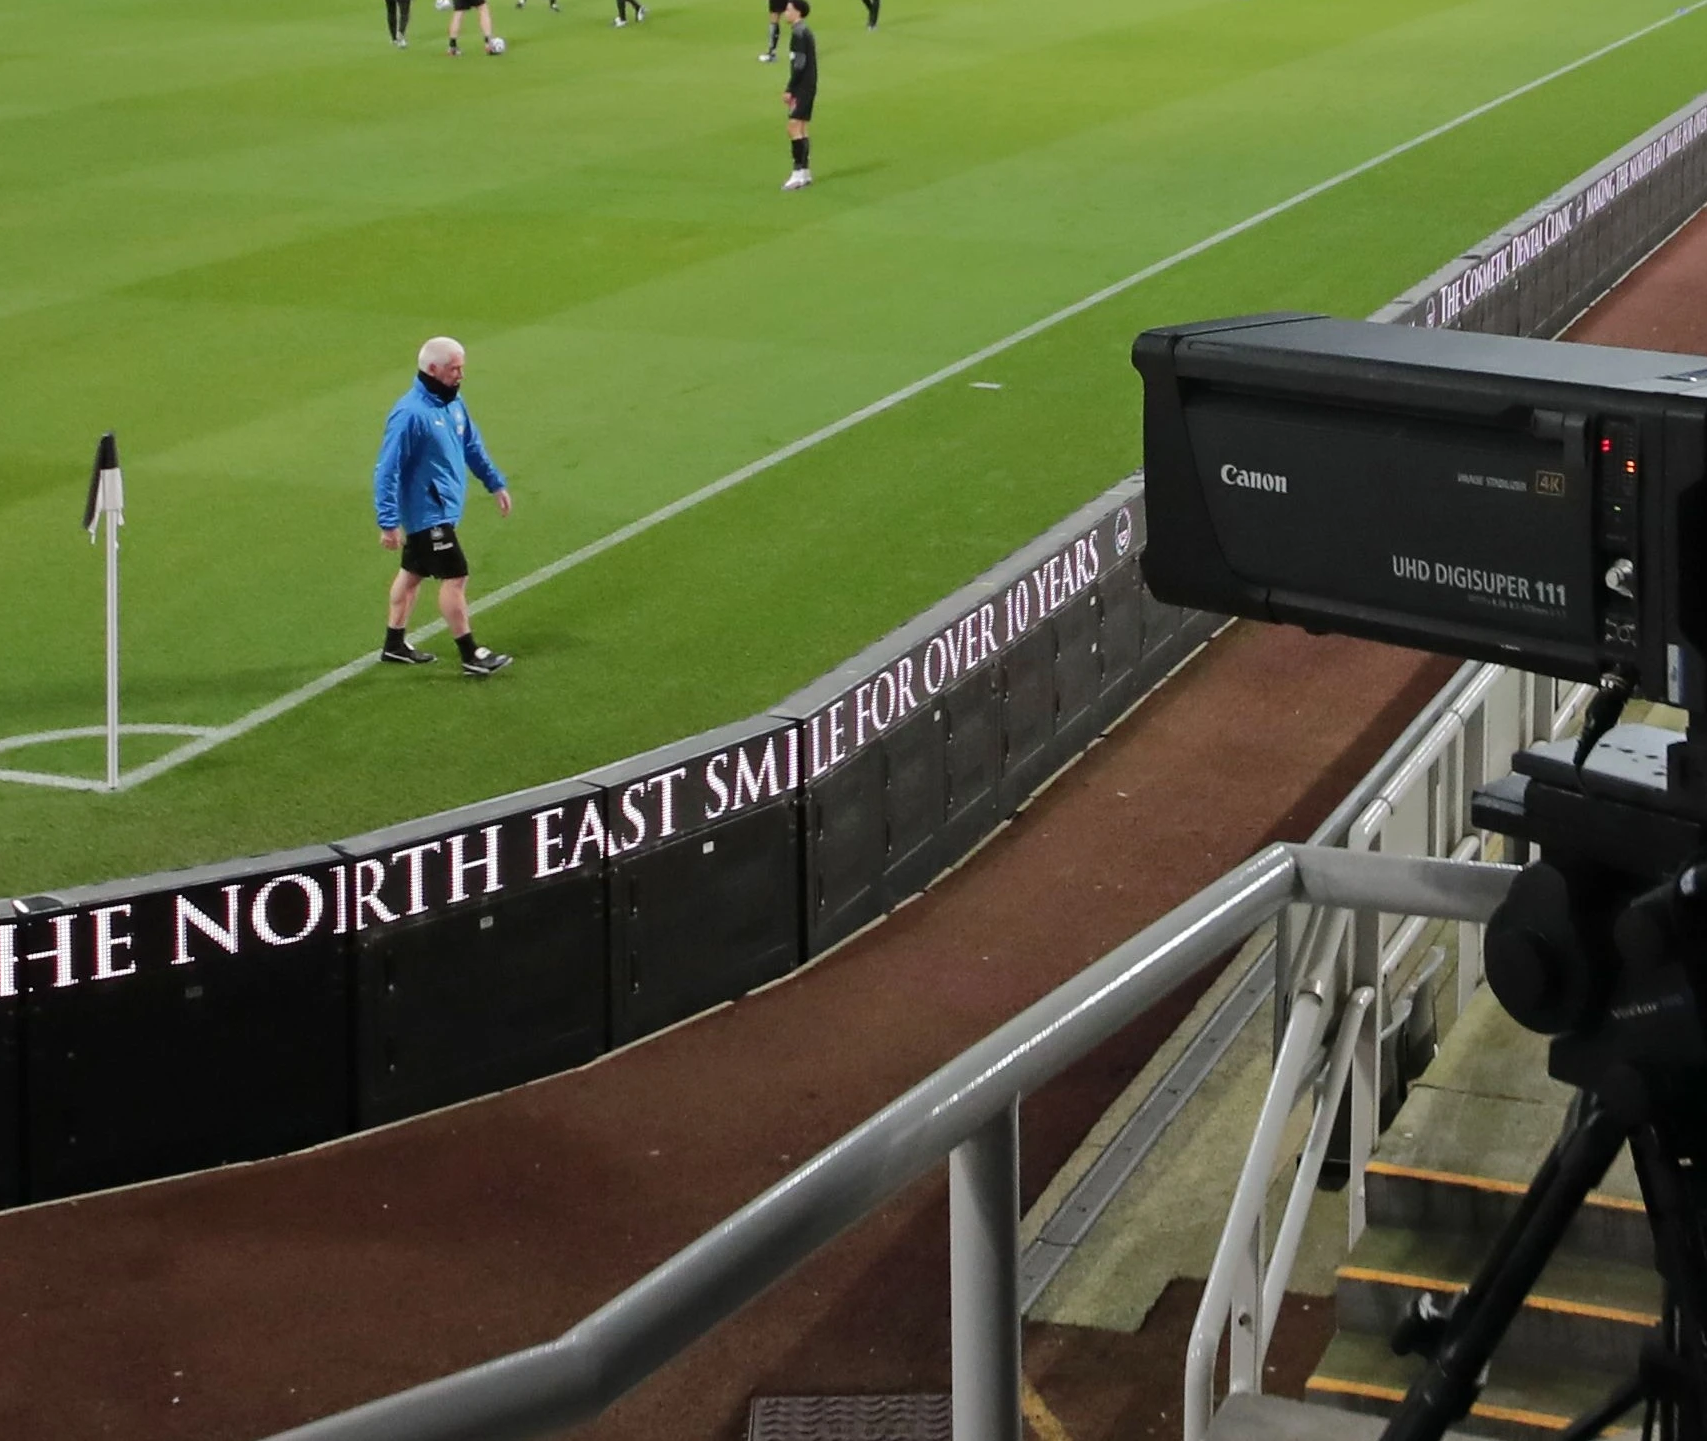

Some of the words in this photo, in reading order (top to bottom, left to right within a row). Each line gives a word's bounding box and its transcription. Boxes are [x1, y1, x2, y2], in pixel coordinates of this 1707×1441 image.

[1440, 280, 1462, 324] THE
[1462, 246, 1511, 306] COSMETIC
[1512, 223, 1544, 271] DENTAL
[1545, 202, 1573, 244] CLINIC
[1220, 464, 1288, 494] Canon
[1539, 475, 1560, 492] 4K
[1392, 554, 1431, 582] UHD
[1435, 562, 1531, 600] DIGISUPER
[1534, 580, 1566, 606] 111
[171, 824, 504, 966] NORTH
[532, 766, 687, 880] EAST
[704, 700, 847, 821] SMILE
[854, 656, 919, 748] FOR
[923, 602, 999, 695] OVER
[1003, 579, 1031, 642] 10
[1031, 529, 1100, 618] YEARS
